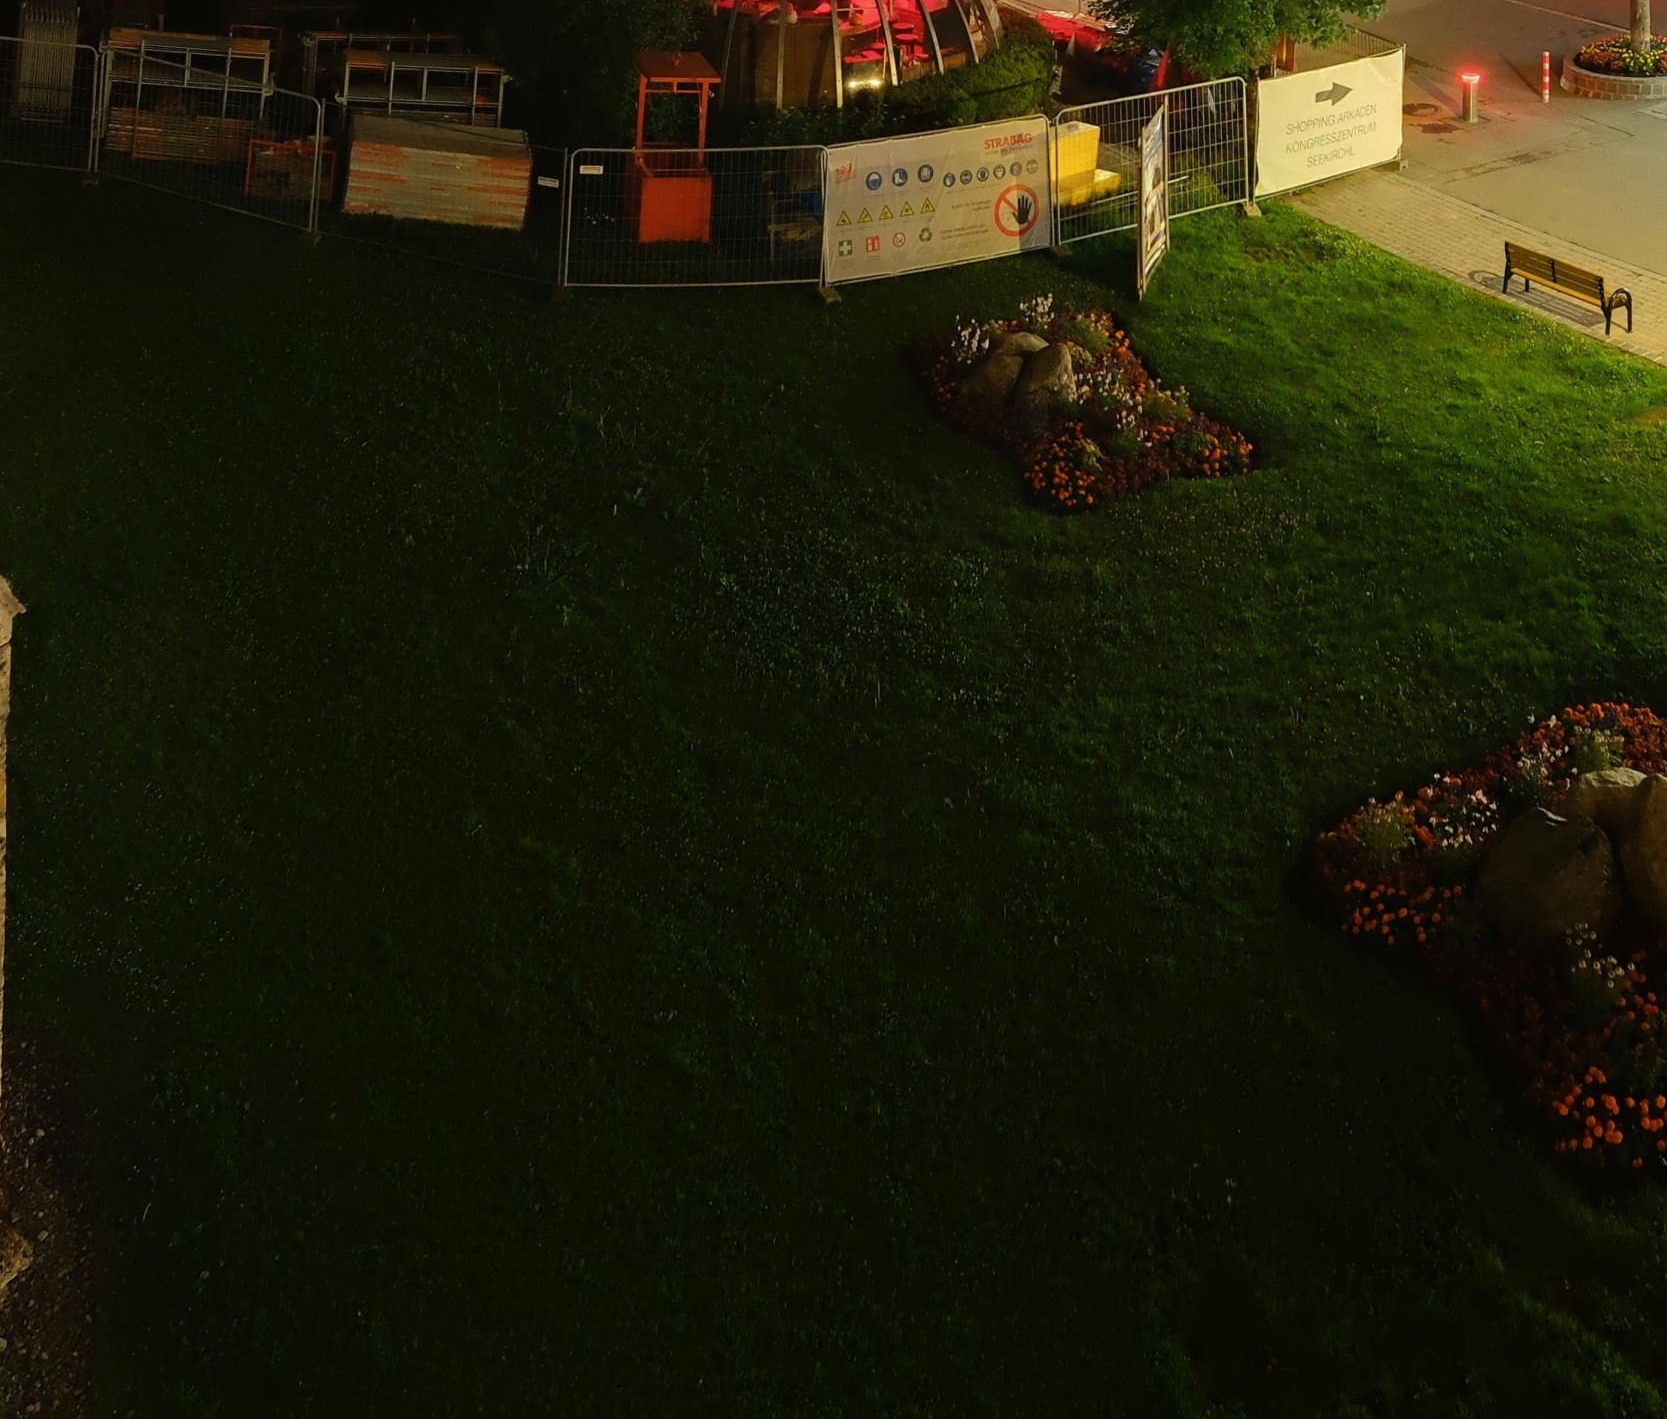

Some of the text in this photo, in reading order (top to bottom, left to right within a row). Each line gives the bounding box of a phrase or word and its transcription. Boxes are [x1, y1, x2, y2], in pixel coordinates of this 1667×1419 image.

[1285, 104, 1378, 136] SHOPPING ARKADEN
[1285, 122, 1378, 154] KONGRESSZENTRUM
[1306, 146, 1356, 169] SEEKIRCHL
